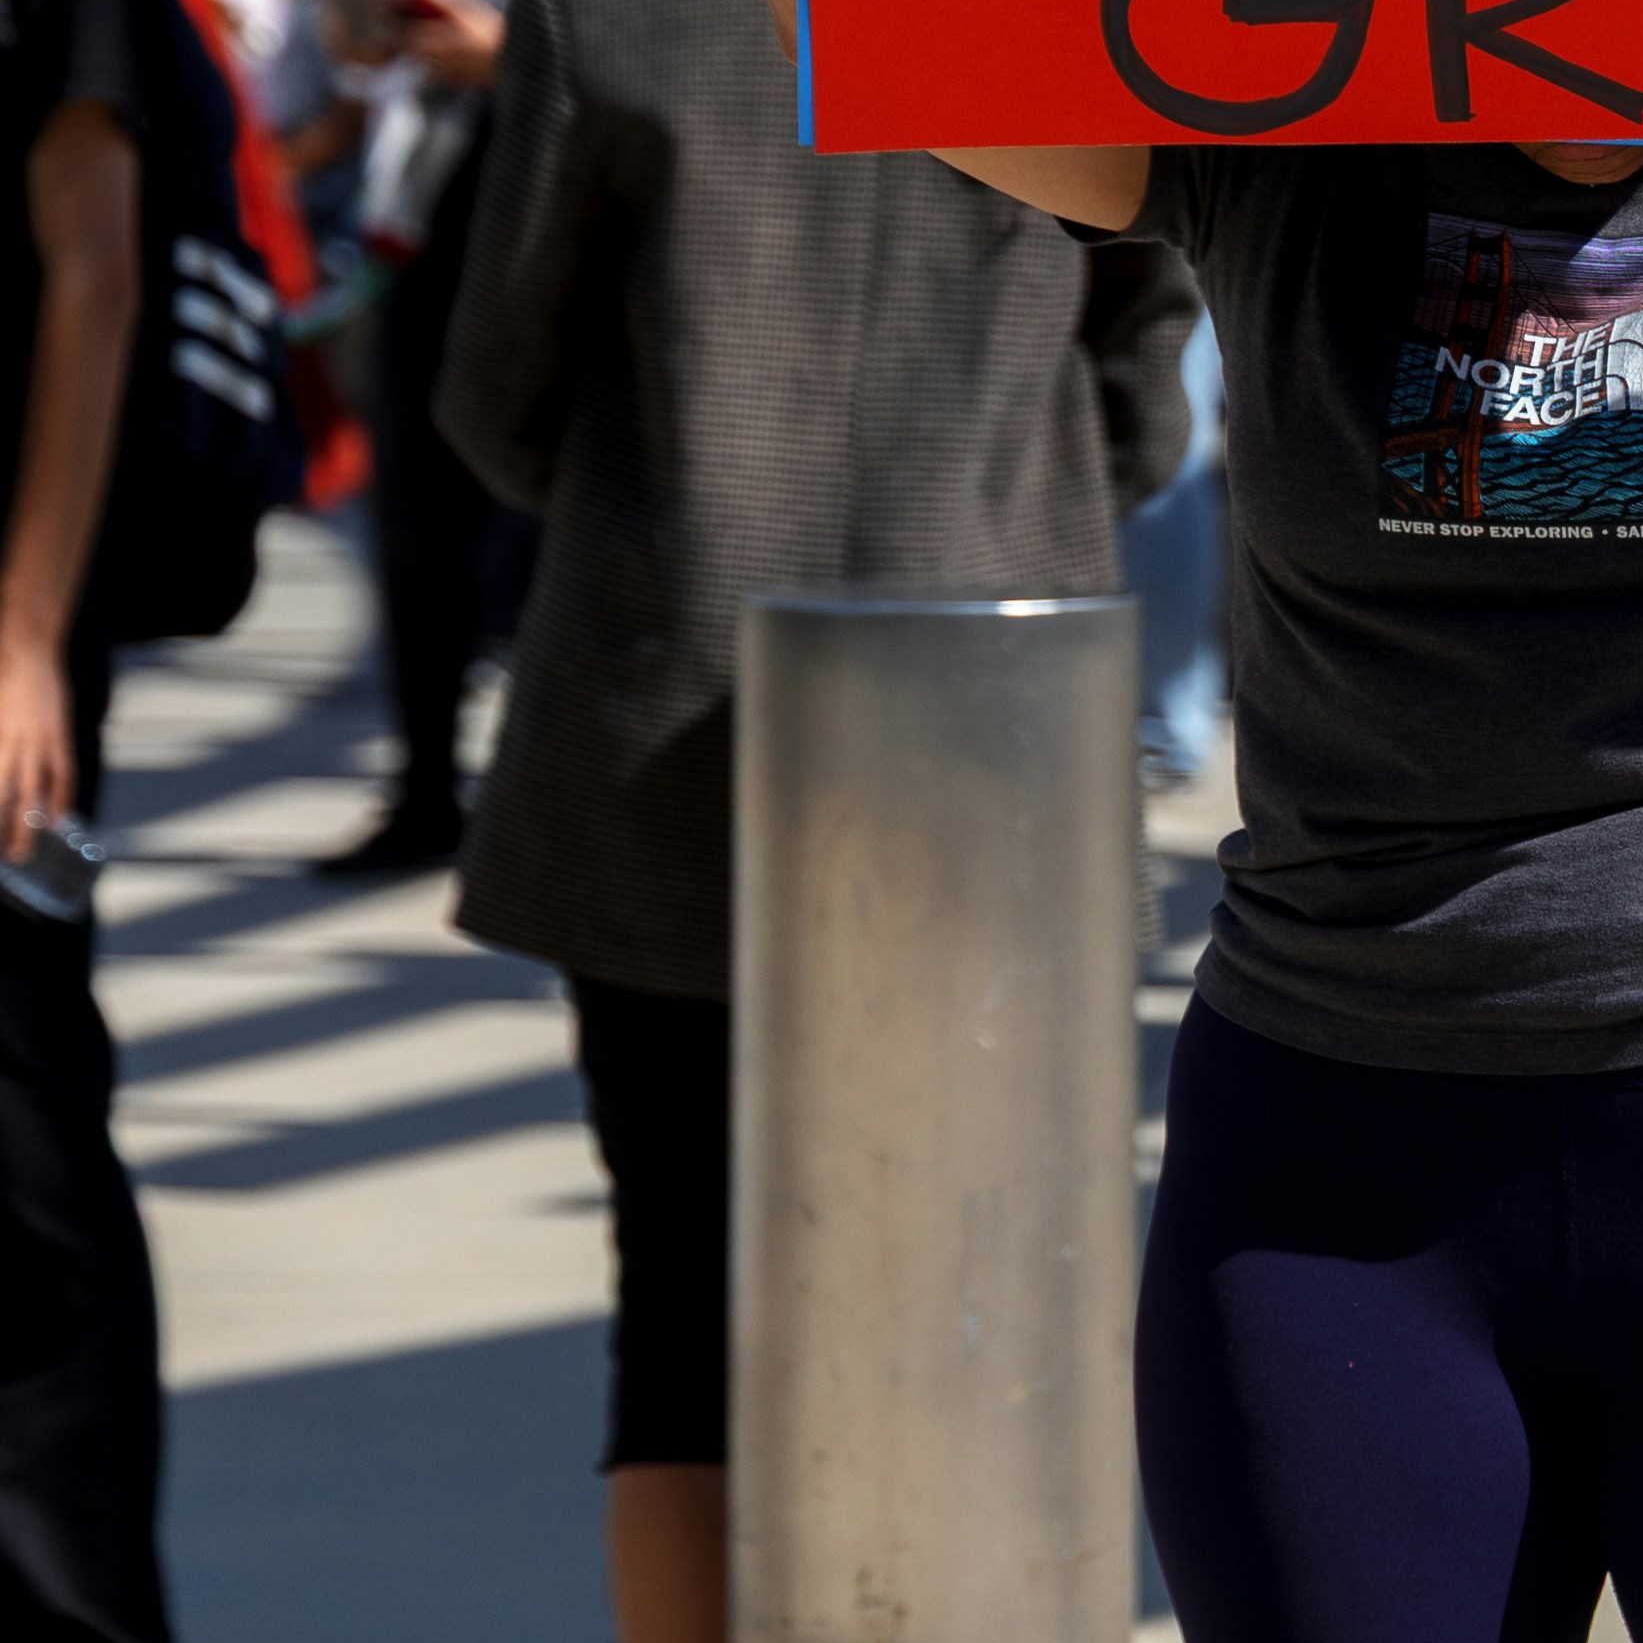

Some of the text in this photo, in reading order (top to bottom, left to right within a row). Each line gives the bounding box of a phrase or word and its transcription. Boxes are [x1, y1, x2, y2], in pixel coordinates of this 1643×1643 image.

[1524, 322, 1613, 367] THE
[1434, 341, 1605, 397] NORTH
[1479, 378, 1603, 426] FACE
[1378, 518, 1435, 536] NEVER
[1439, 523, 1485, 538] STOP
[1489, 525, 1594, 539] EXPLORING
